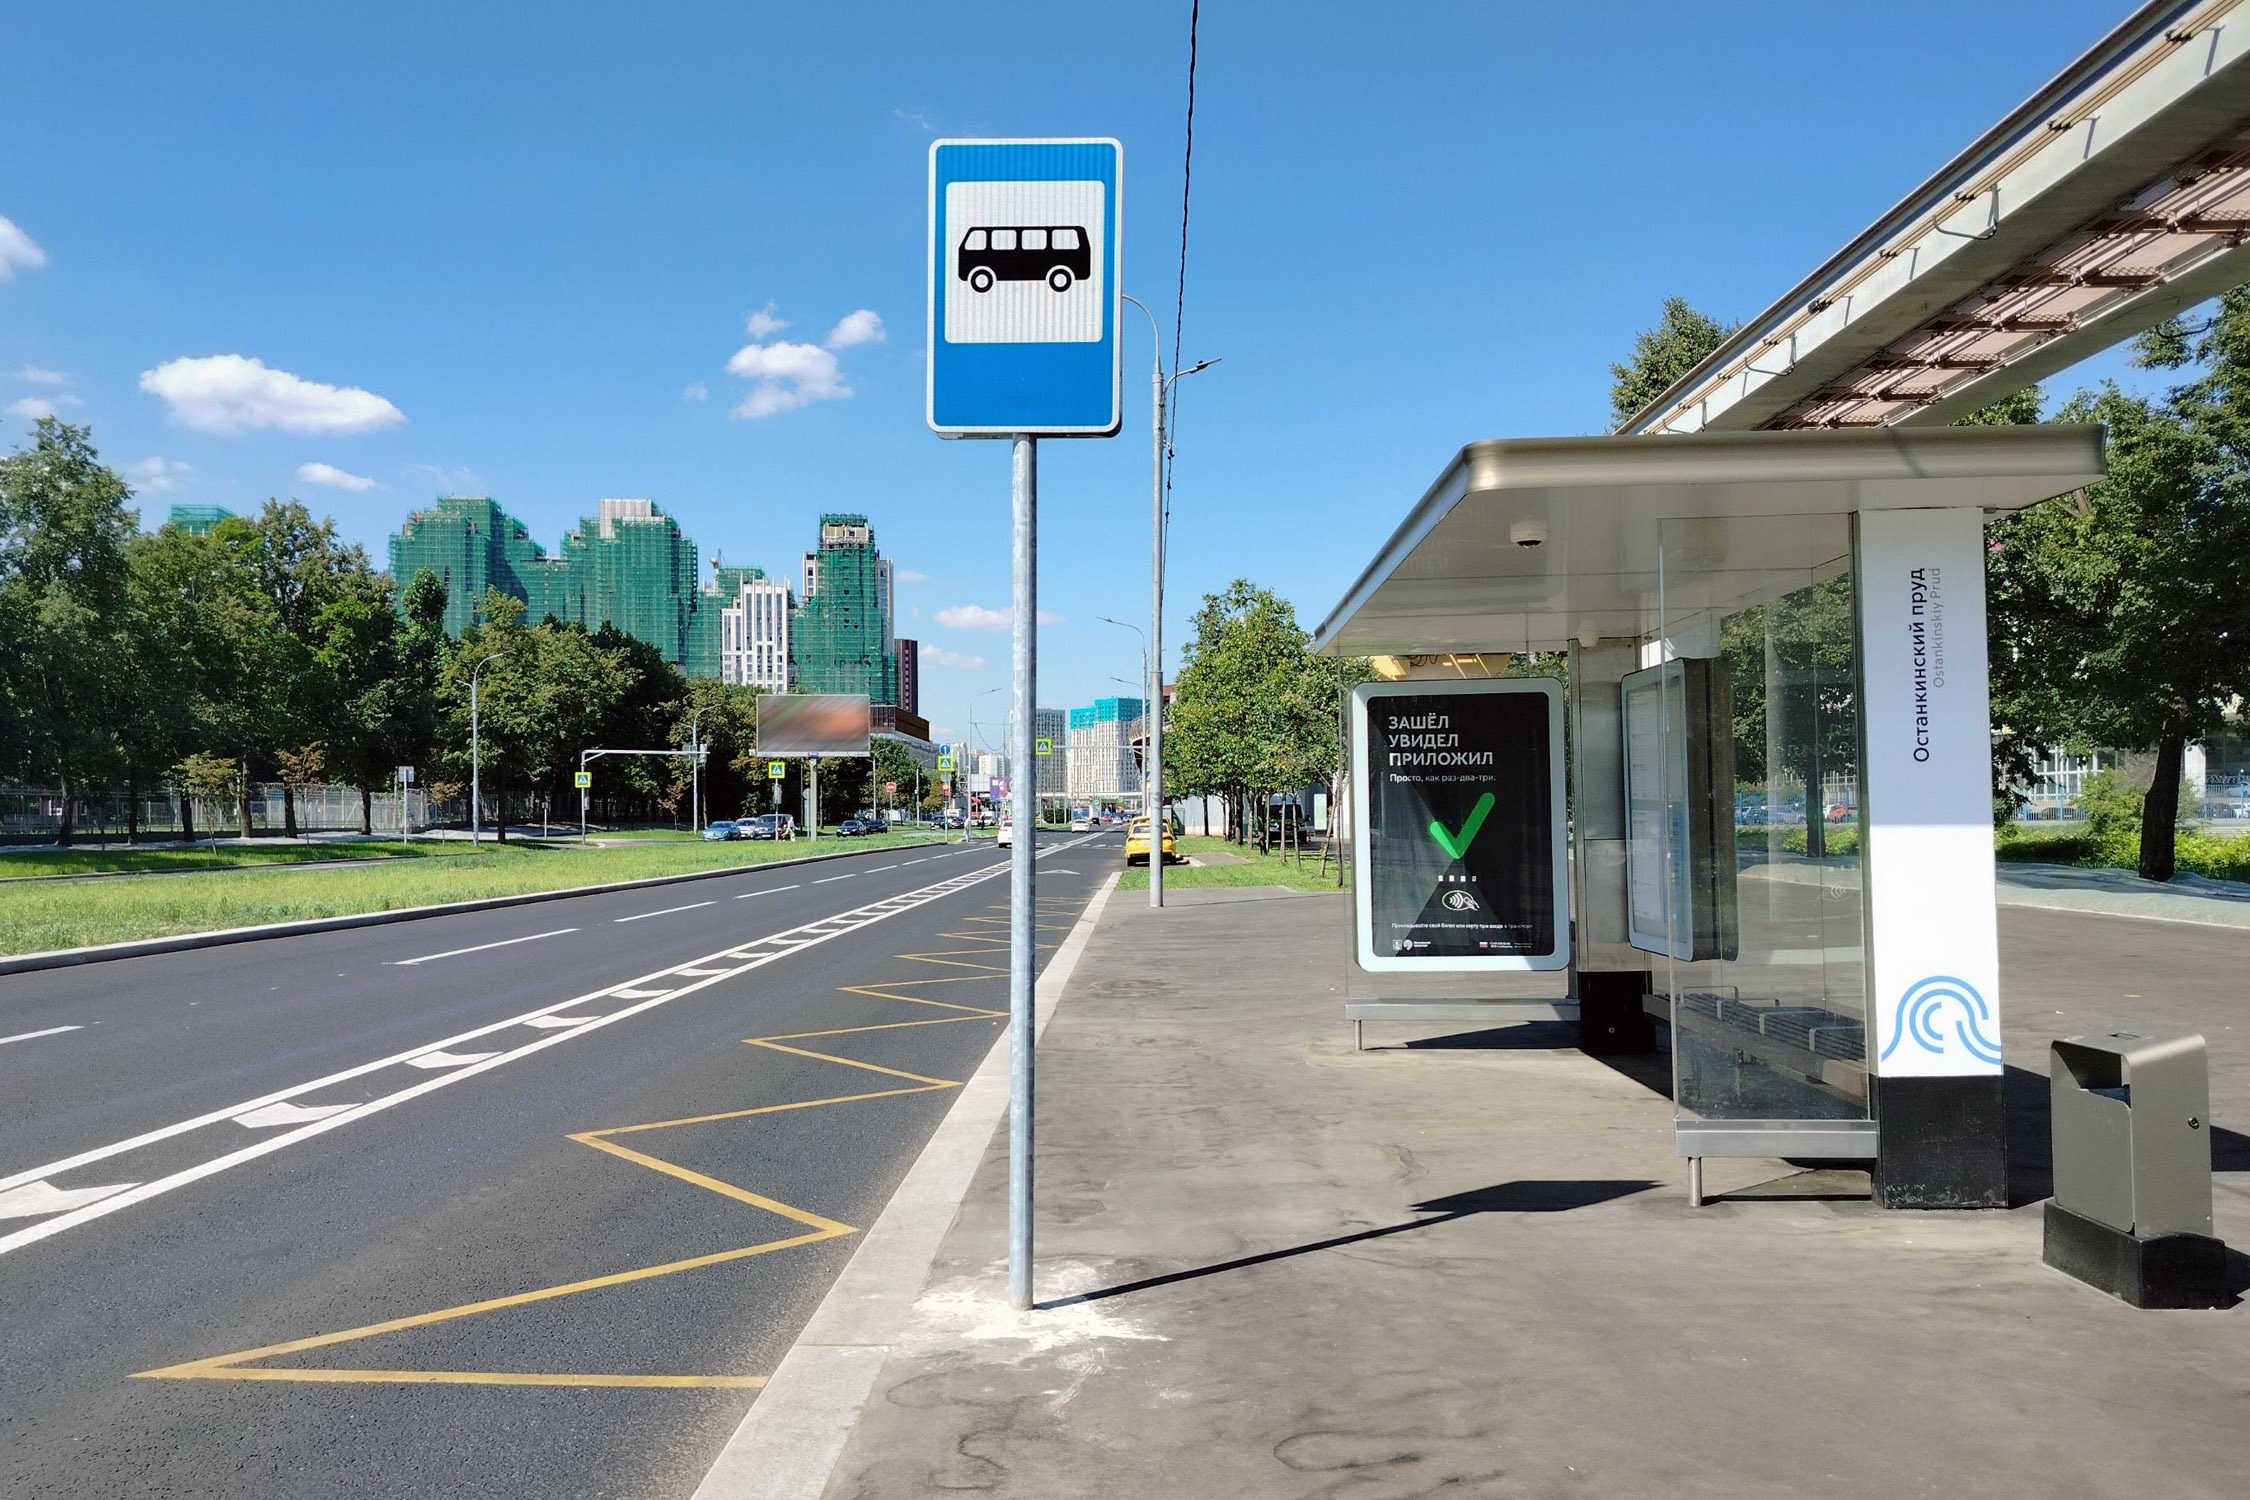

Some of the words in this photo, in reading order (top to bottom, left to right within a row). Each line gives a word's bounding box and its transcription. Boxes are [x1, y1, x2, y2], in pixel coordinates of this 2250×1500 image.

[1910, 568, 1928, 616] пруд
[1928, 567, 1942, 598] Prud
[1931, 603, 1945, 688] Ostankinskiy
[1908, 622, 1929, 763] Останкинский
[1388, 712, 1449, 730] ЗАШЁЛ
[1388, 733, 1459, 750] УВИДЕЛ
[1388, 751, 1494, 767] ПРИЛОЖИЛ
[1389, 773, 1424, 784] Просто,
[1425, 774, 1440, 782] как
[1441, 773, 1497, 783] раз-два-три.
